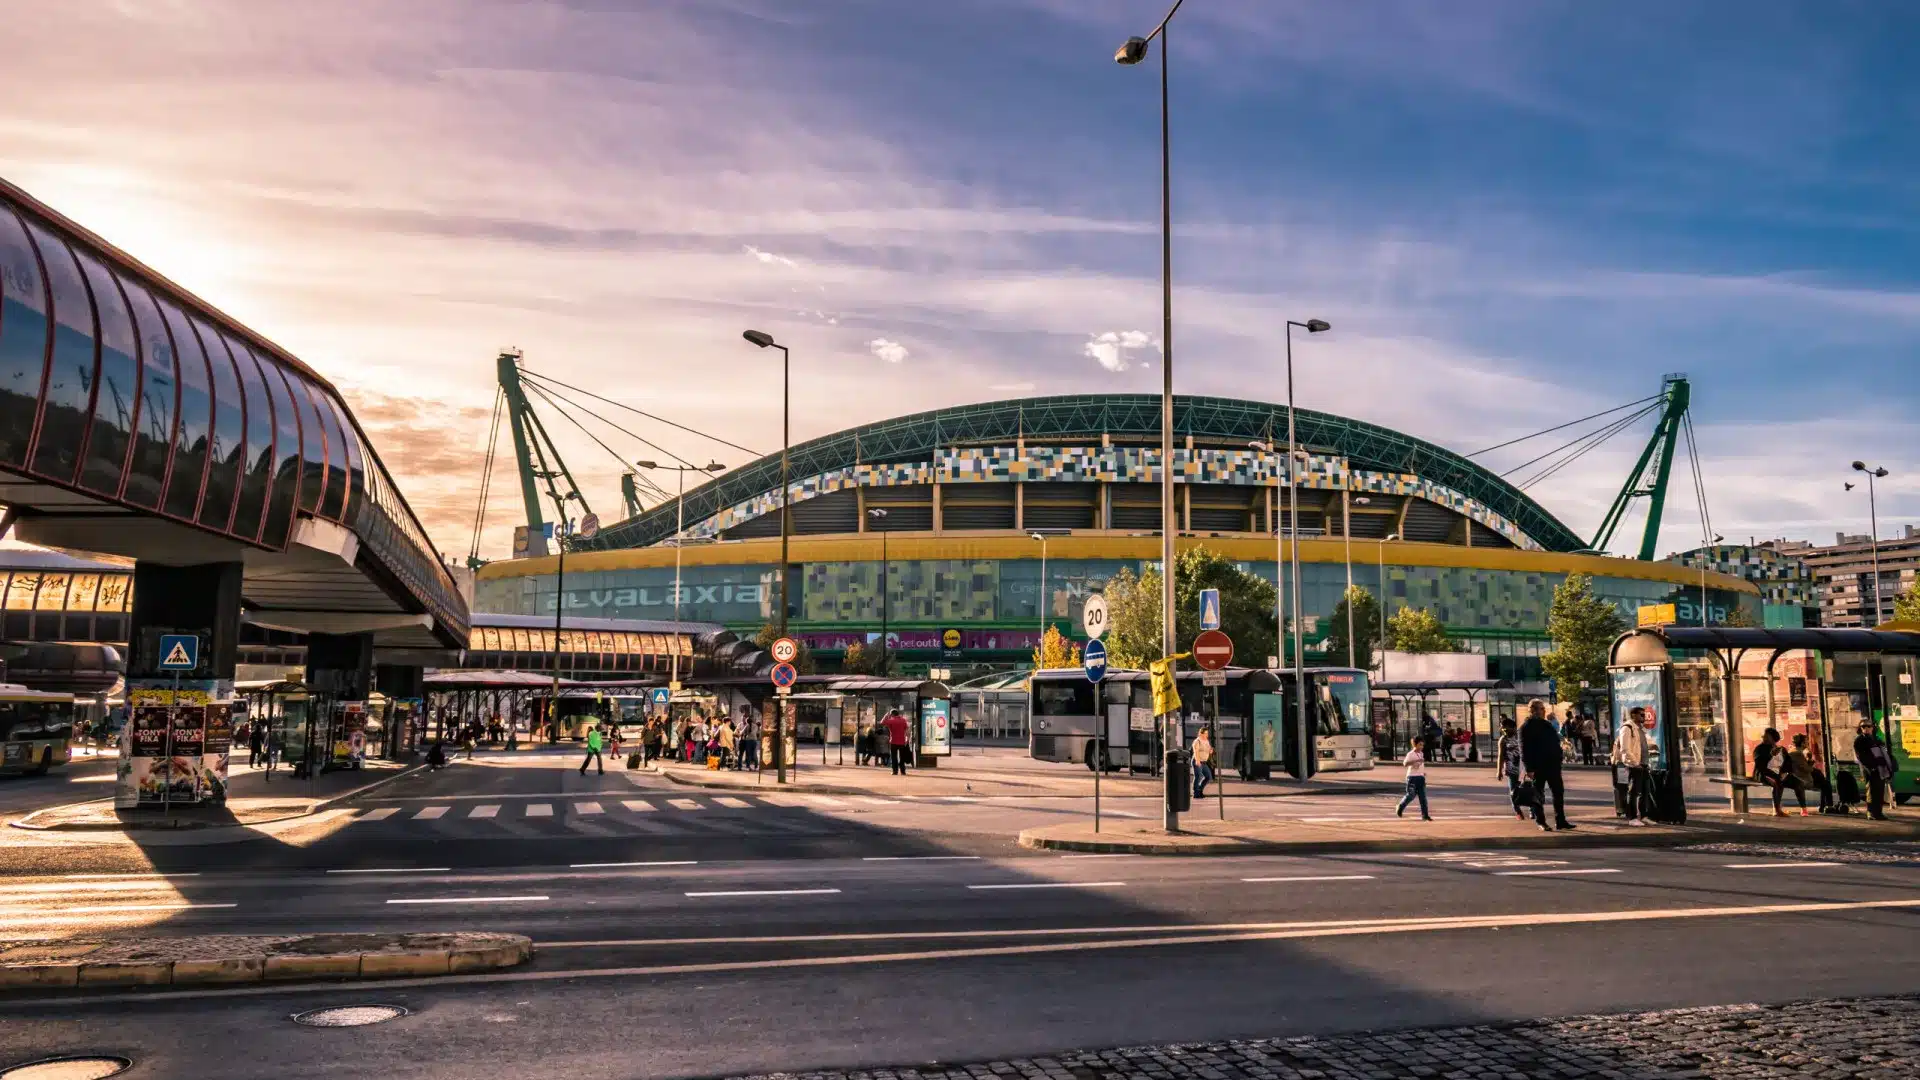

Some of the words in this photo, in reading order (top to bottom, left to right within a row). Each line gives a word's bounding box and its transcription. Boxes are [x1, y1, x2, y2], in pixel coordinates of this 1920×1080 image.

[1088, 608, 1103, 626] 20
[900, 639, 915, 648] pet
[777, 645, 792, 655] 20
[139, 735, 159, 743] FIKA
